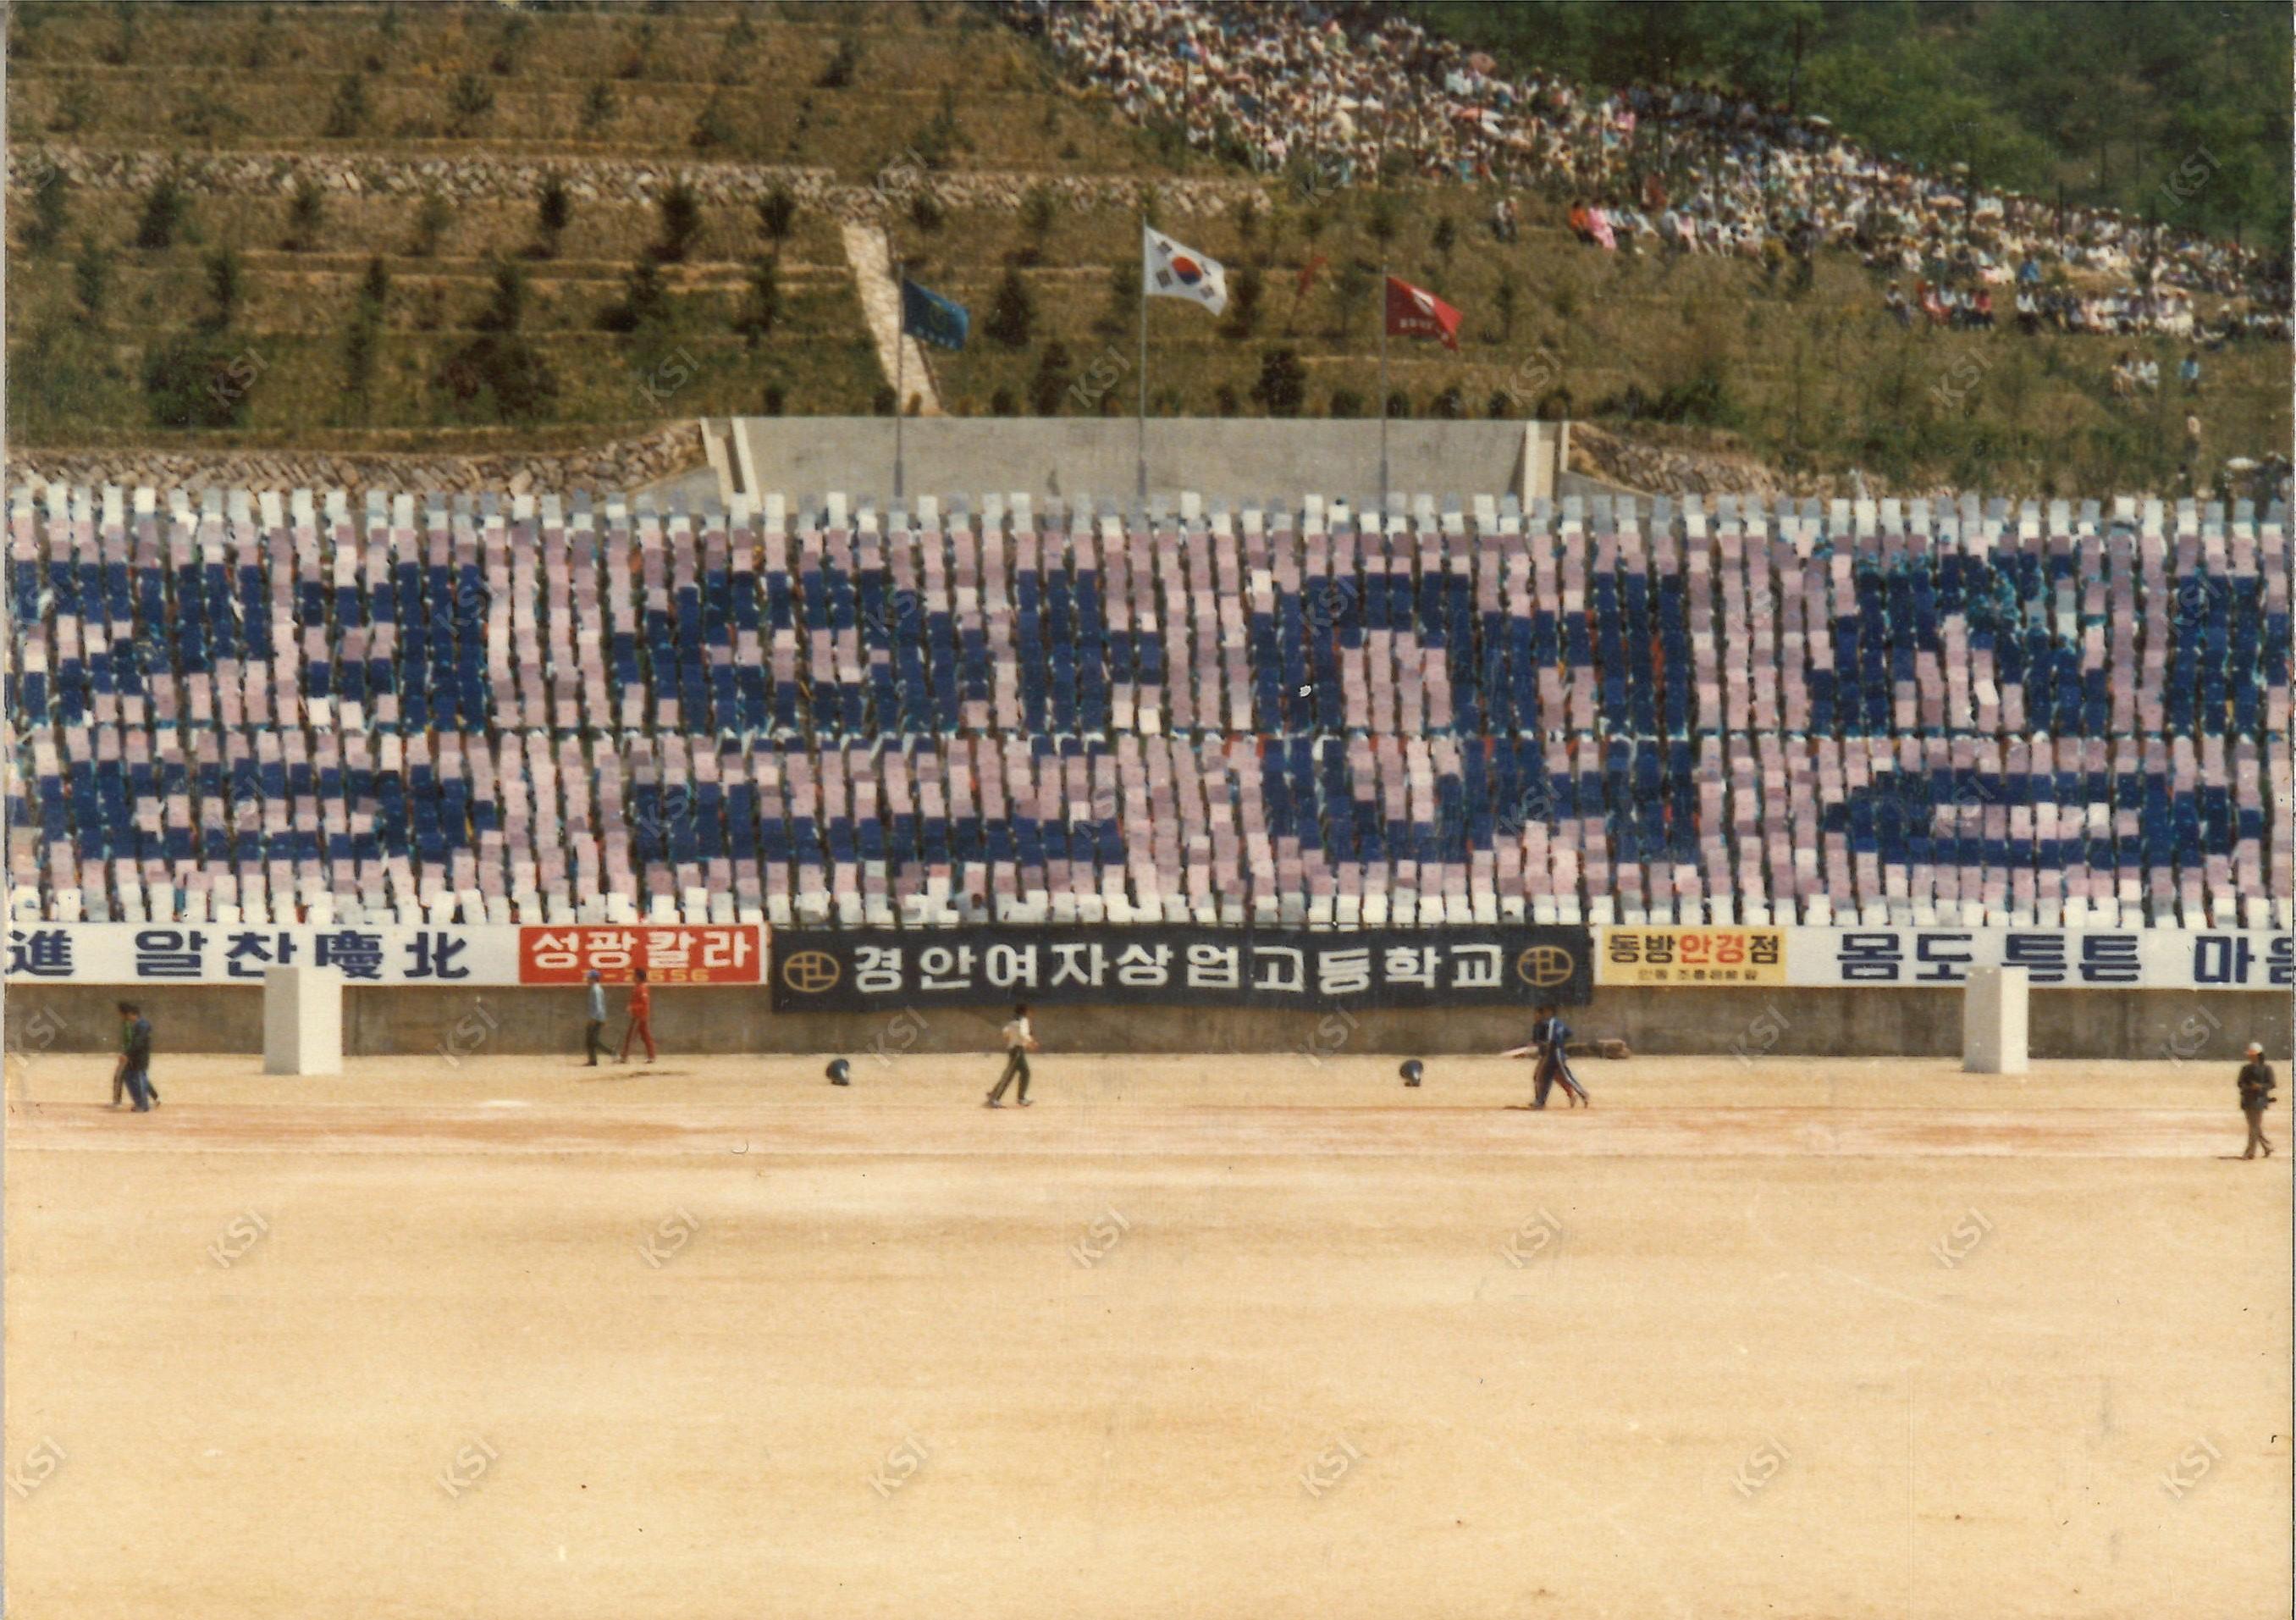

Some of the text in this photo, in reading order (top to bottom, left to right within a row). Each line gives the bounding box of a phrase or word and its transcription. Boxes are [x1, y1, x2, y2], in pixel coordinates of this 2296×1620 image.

[532, 932, 752, 968] 성광칼라
[854, 943, 1504, 995] 경안여자상업고등학교
[1609, 934, 1779, 965] 동방안경점
[1837, 933, 1973, 981] 몸도
[2001, 934, 2141, 981] 튼튼
